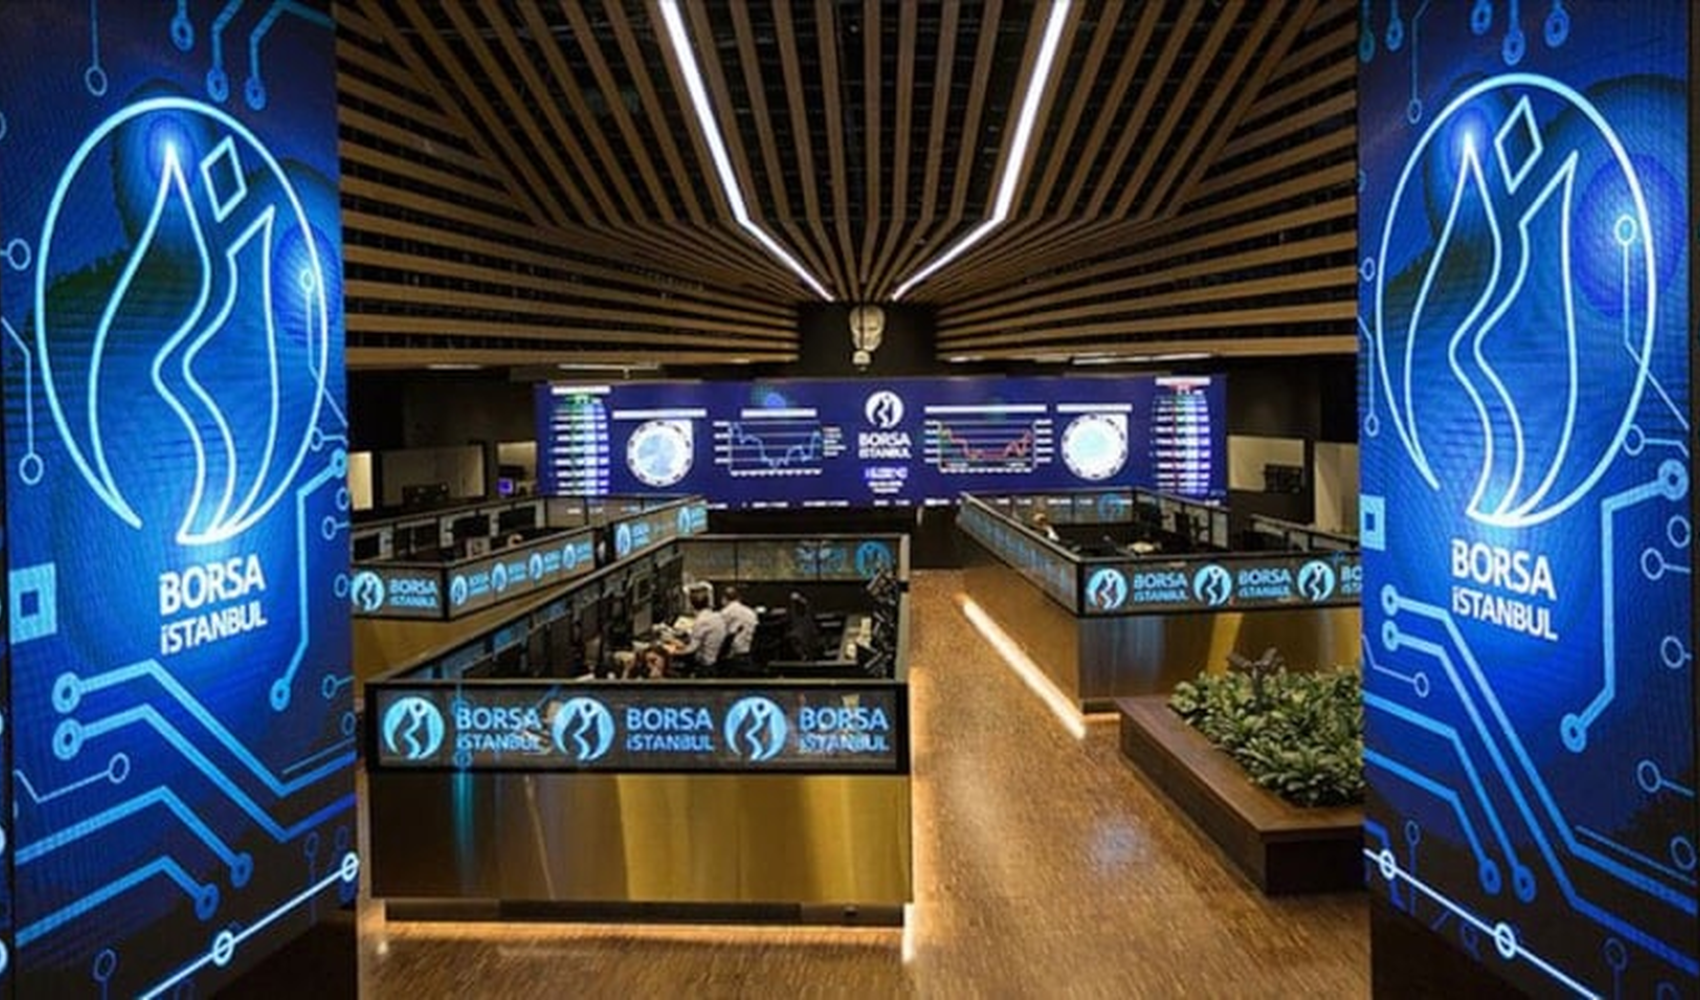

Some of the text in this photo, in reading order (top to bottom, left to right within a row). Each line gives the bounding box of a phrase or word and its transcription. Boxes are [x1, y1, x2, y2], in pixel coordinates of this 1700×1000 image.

[1134, 572, 1188, 589] BORSA
[1238, 568, 1292, 586] BORSA
[1451, 538, 1557, 601] BORSA
[159, 553, 266, 616] BORSA
[457, 707, 542, 730] BORSA
[627, 707, 714, 731] BORSA
[799, 707, 889, 731] BORSA
